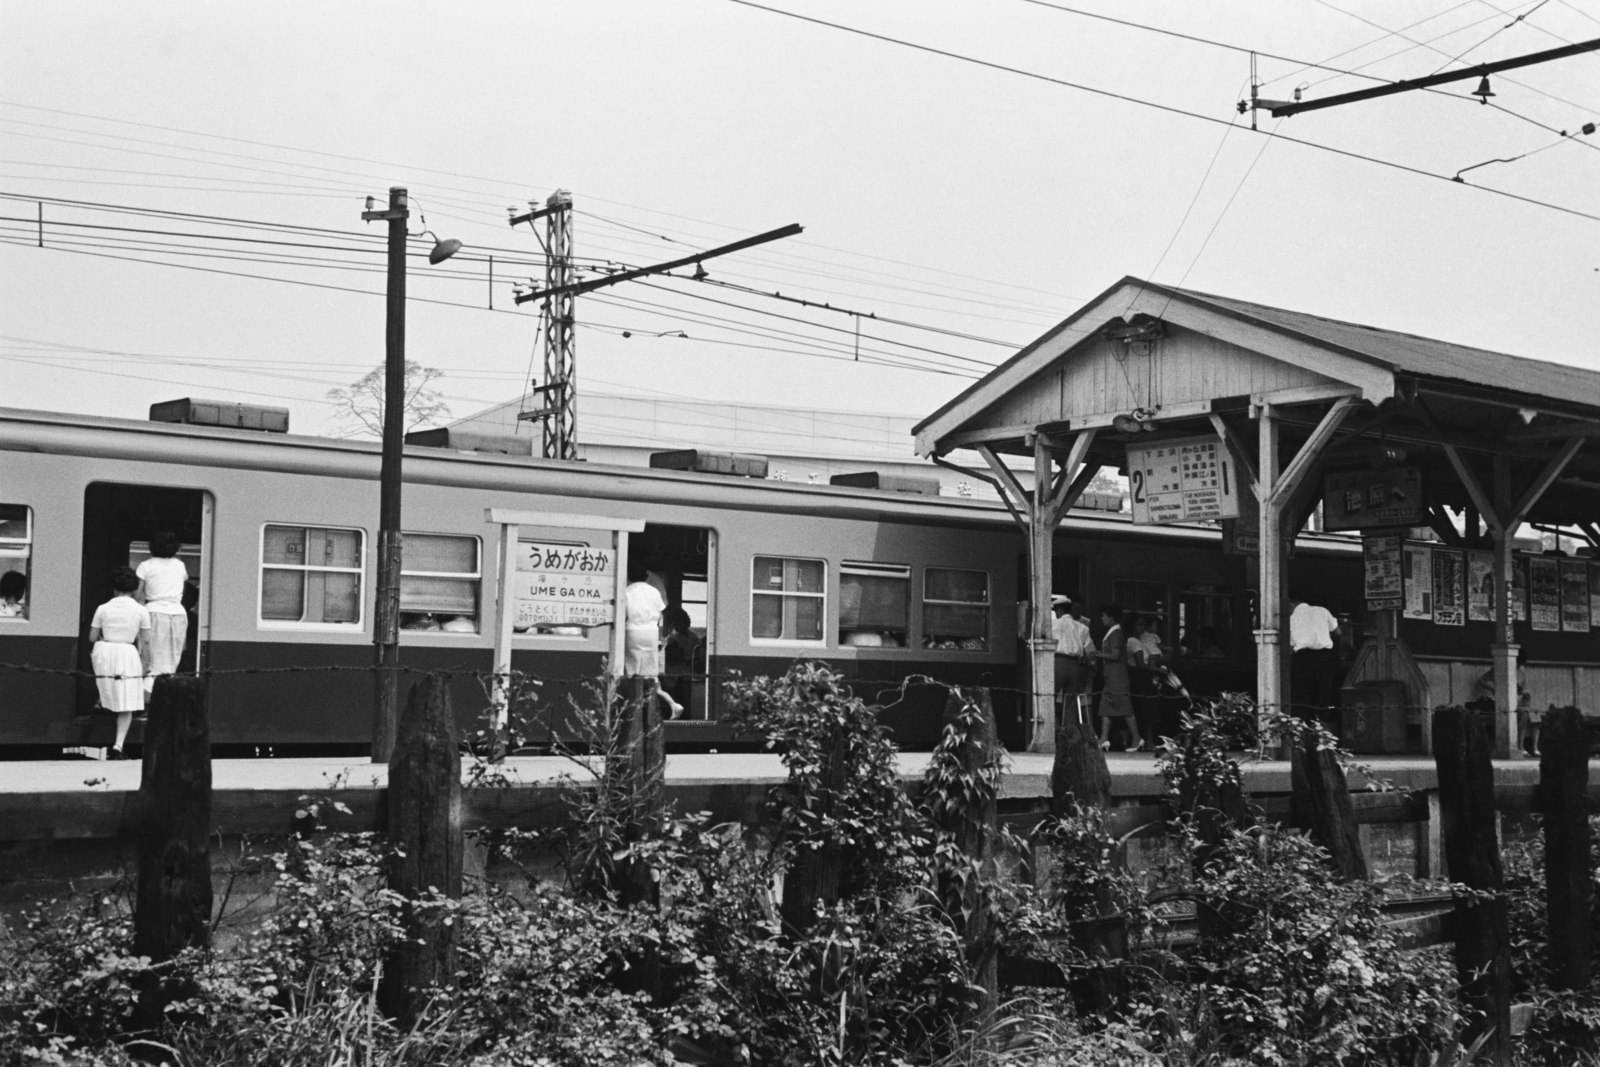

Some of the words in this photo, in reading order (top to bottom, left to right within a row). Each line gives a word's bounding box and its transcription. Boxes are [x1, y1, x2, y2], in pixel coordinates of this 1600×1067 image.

[1132, 470, 1146, 504] 2
[529, 546, 609, 572] うめがおか
[530, 586, 556, 596] UME
